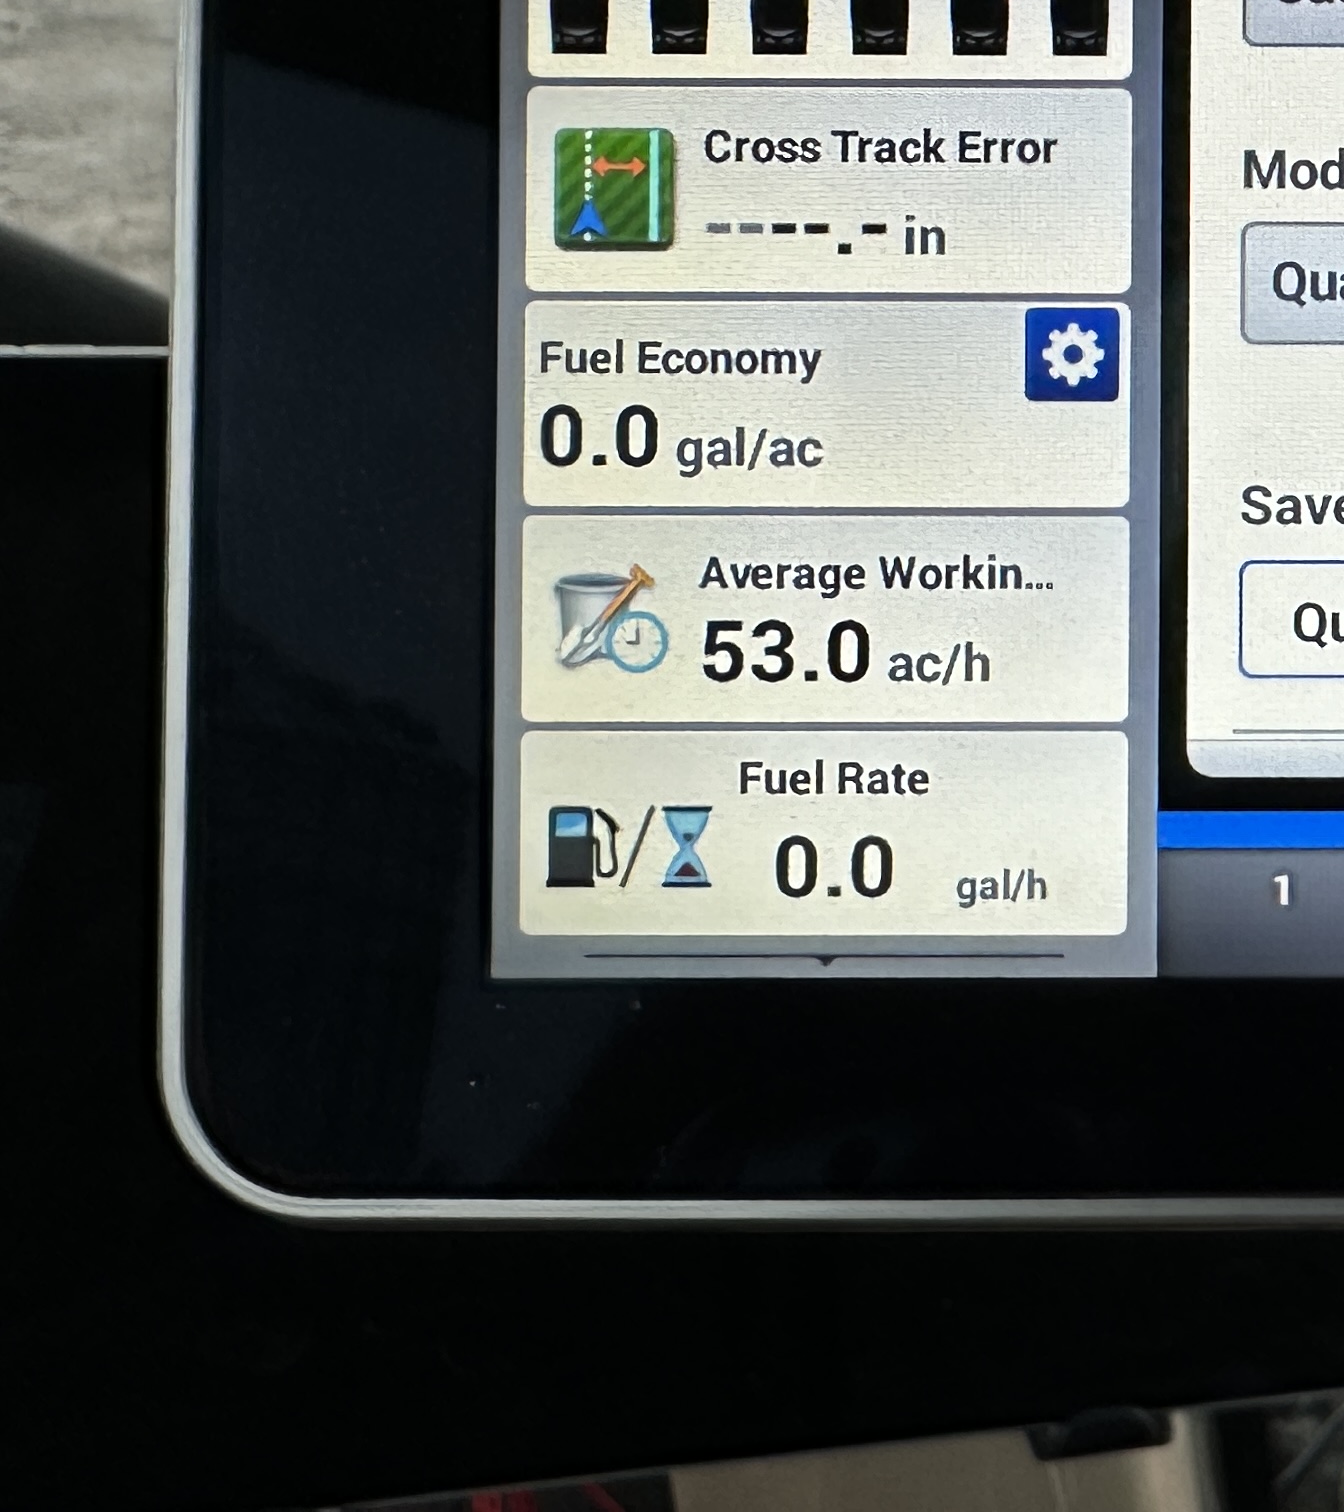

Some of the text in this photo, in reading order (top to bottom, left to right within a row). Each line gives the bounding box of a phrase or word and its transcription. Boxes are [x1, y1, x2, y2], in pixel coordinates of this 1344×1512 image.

[705, 128, 1057, 164] Cross Track Error
[905, 215, 945, 255] in
[541, 339, 821, 384] Fuel Economy
[541, 404, 822, 478] 0.0 gal/ac
[699, 554, 1053, 598] Average Workin...
[703, 620, 989, 685] 53.0 ac/h
[740, 759, 929, 795] Fuel Rate
[776, 835, 1047, 908] 0.0 gal/h
[1274, 875, 1288, 905] 1
